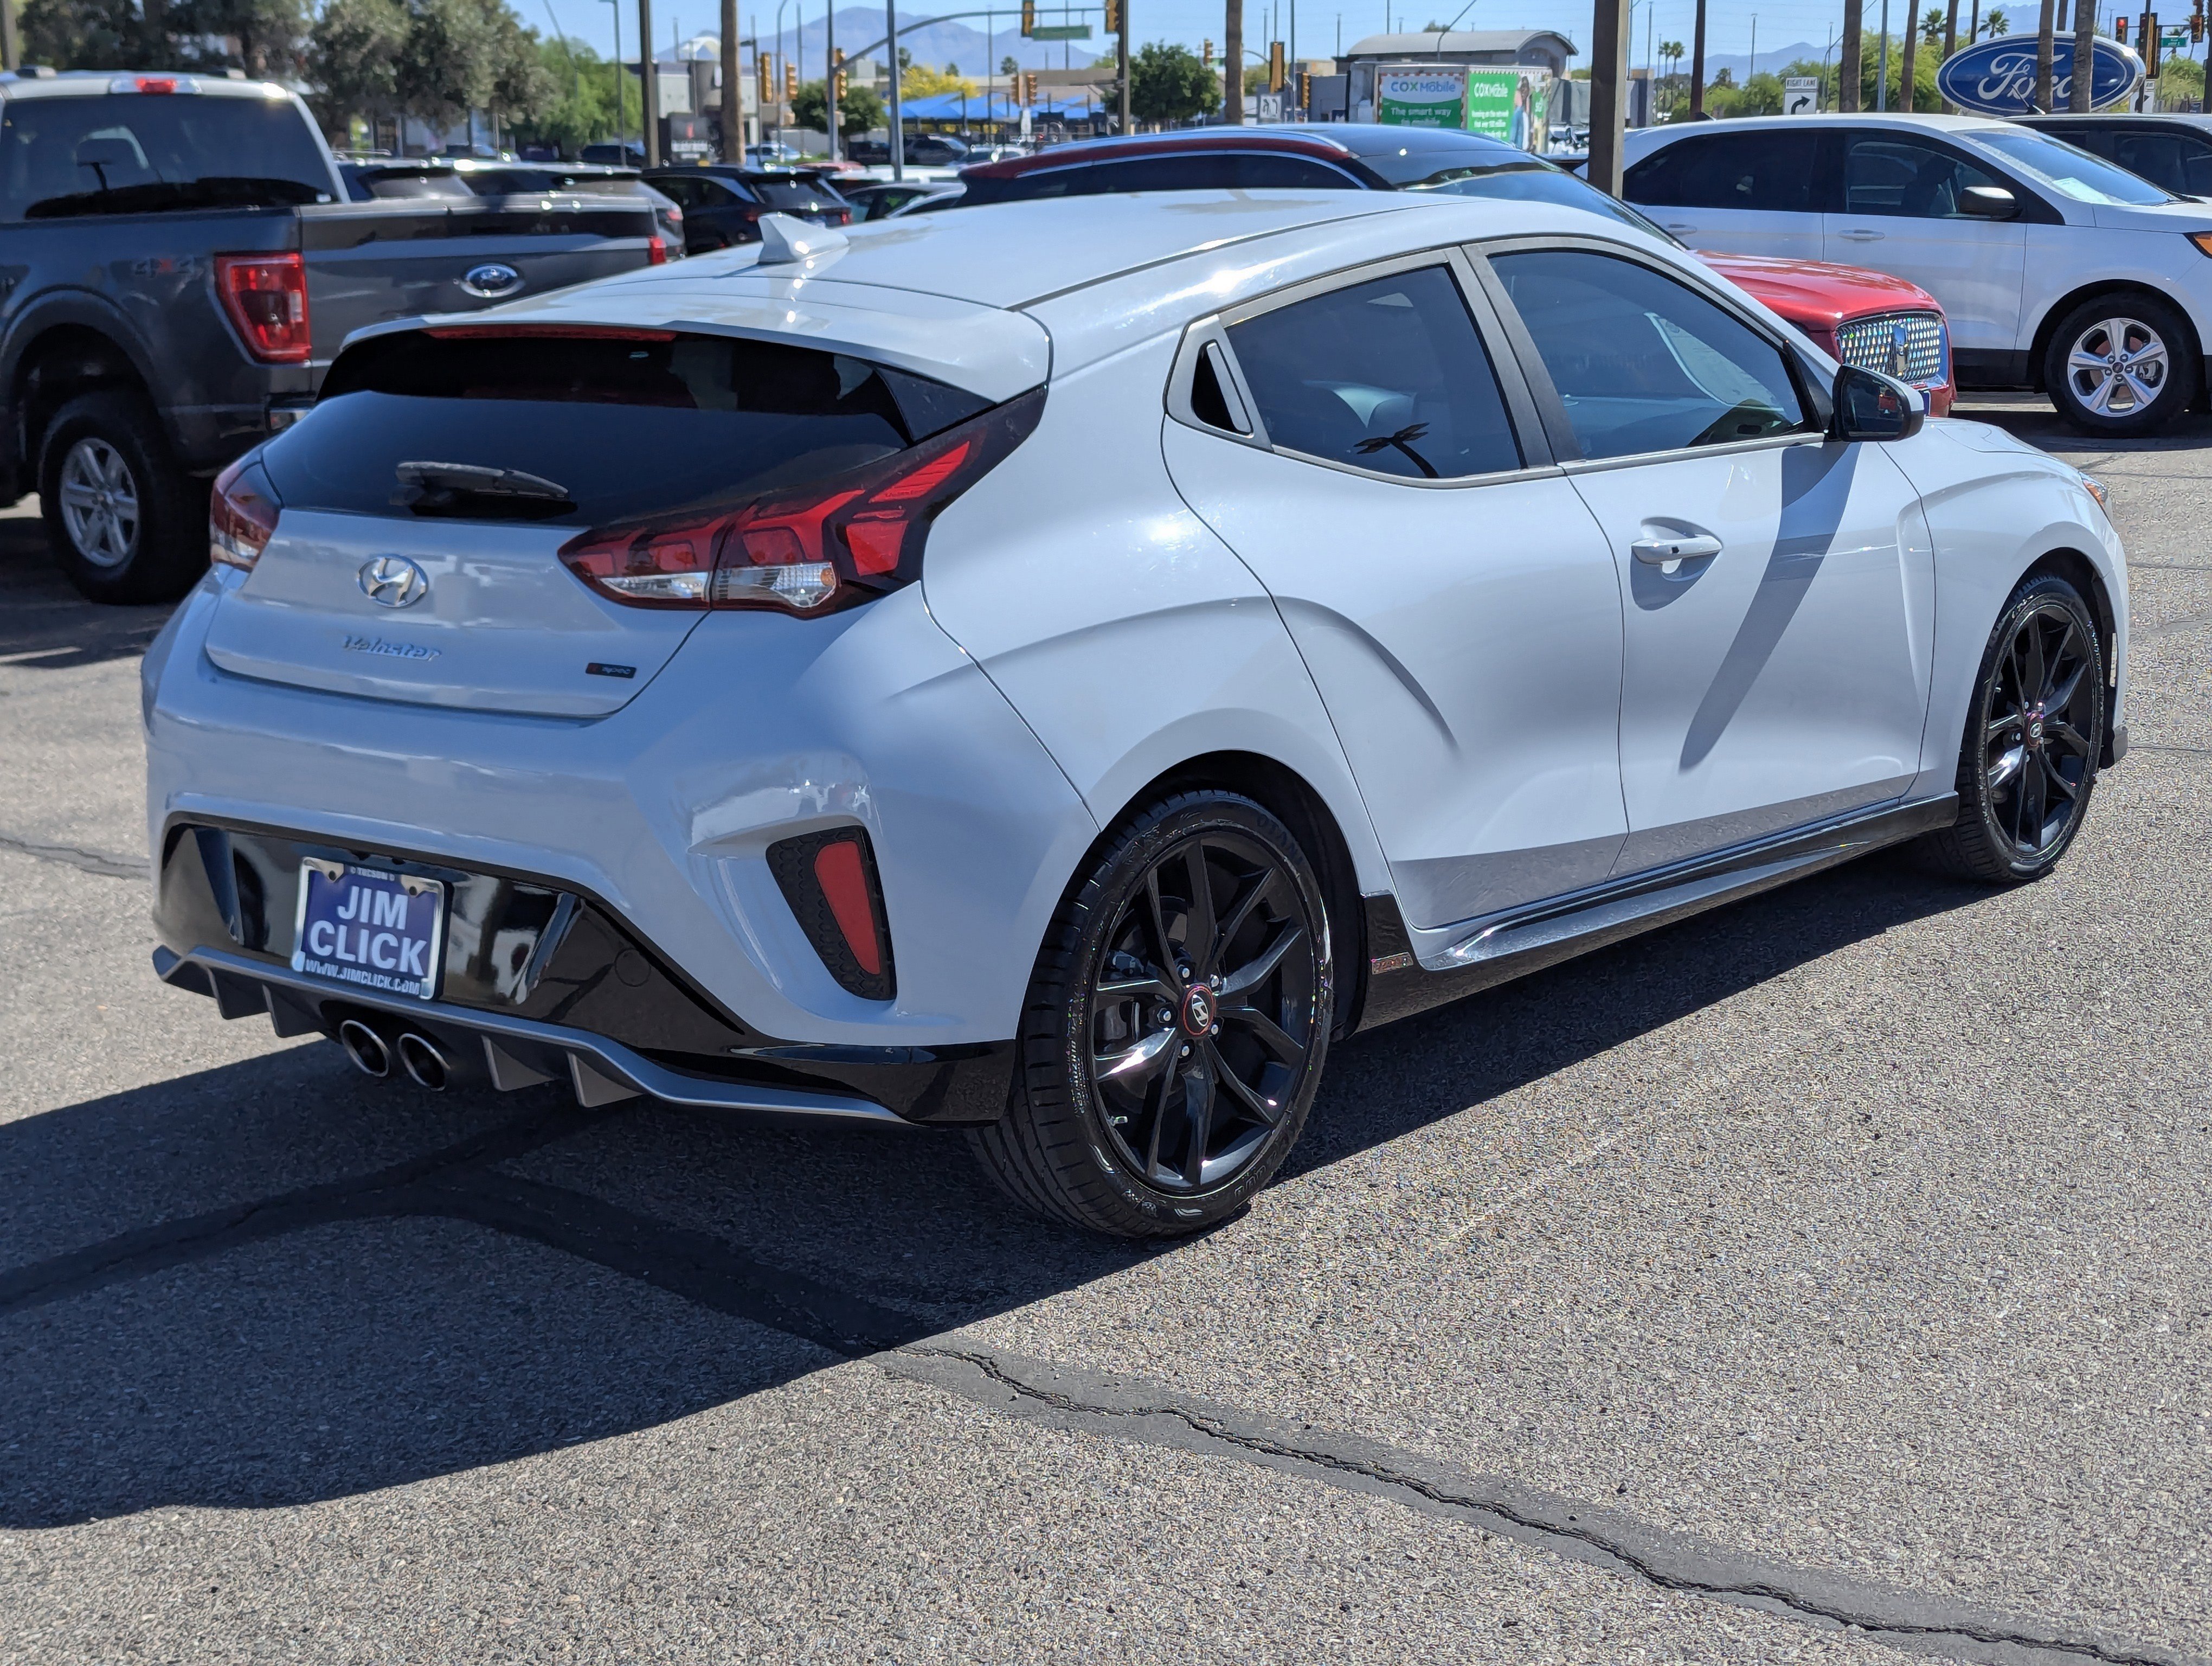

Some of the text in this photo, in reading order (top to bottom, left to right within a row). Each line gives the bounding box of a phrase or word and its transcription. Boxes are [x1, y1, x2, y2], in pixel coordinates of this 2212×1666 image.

[1391, 81, 1456, 92] COX Mobile
[1474, 82, 1490, 97] COX
[1391, 107, 1406, 116] The
[337, 885, 408, 930] JIM
[310, 920, 427, 976] CLICK
